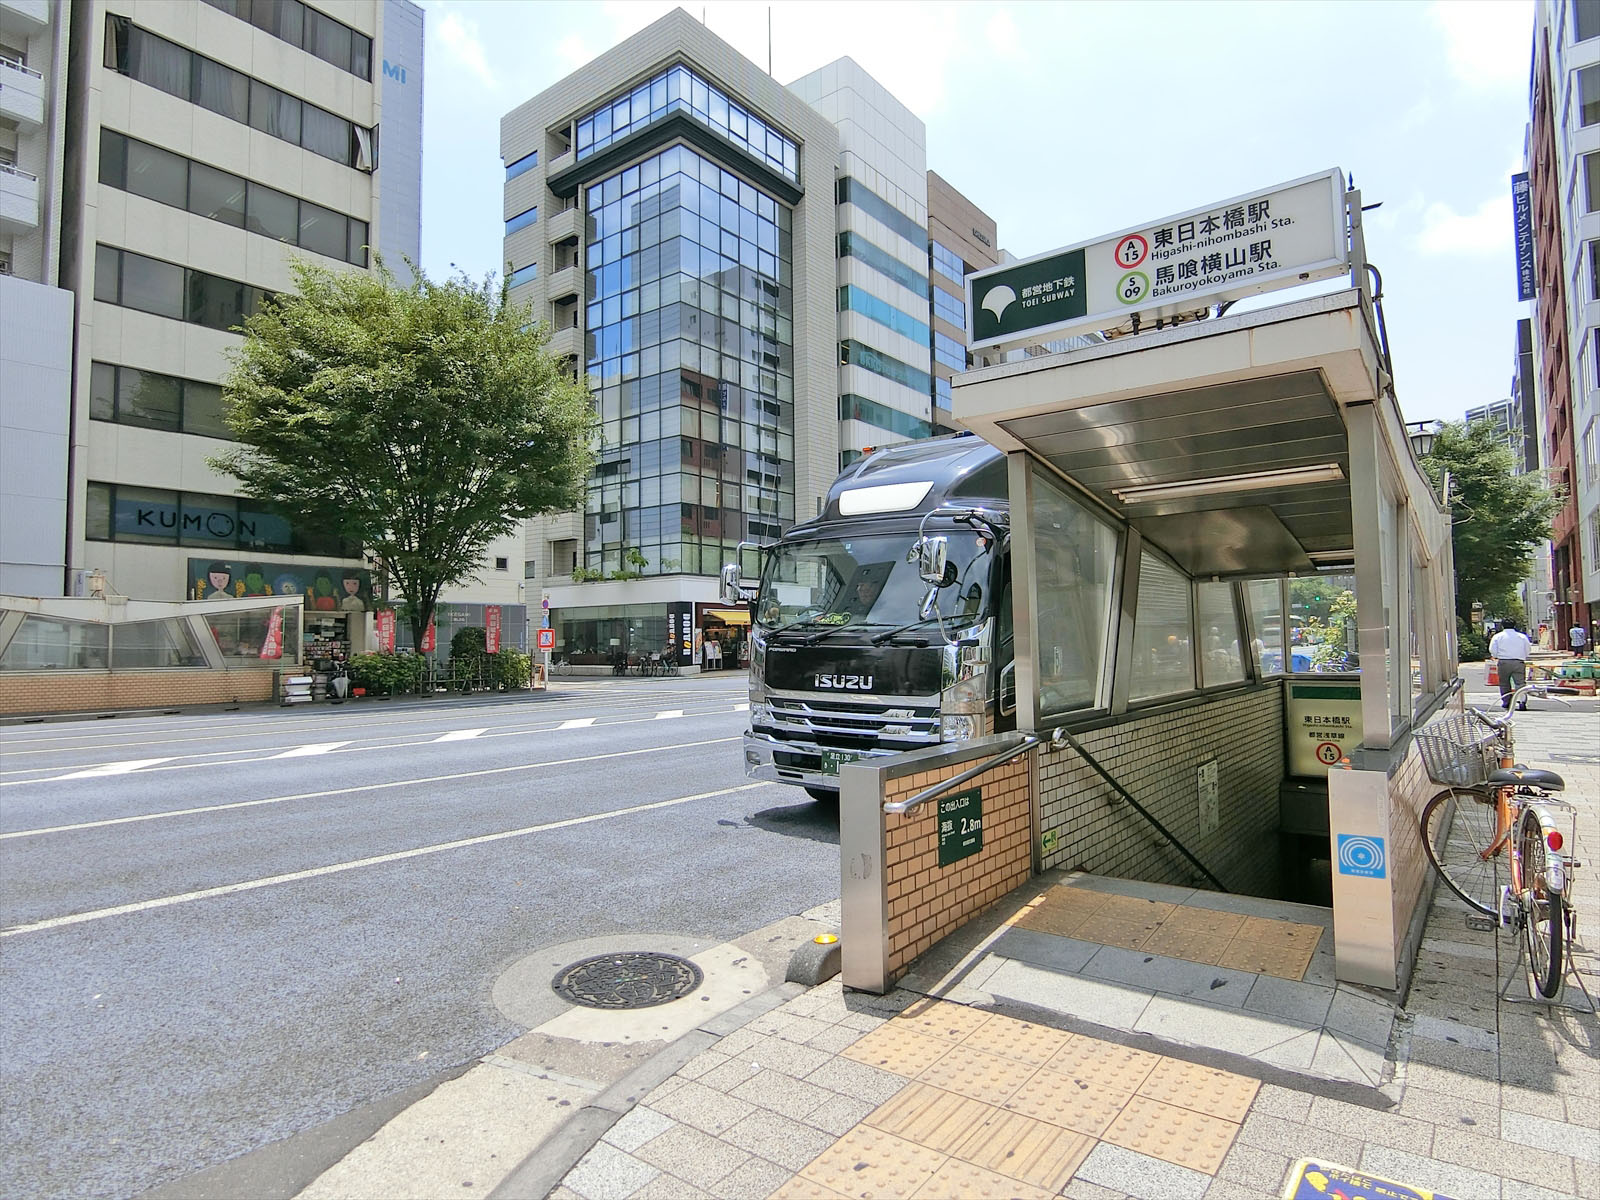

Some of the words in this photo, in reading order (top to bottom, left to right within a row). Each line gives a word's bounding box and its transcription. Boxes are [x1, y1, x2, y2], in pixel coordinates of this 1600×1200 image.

[1153, 200, 1270, 249] 東日本橋駅
[1127, 241, 1135, 251] A
[1151, 221, 1267, 261] Higashi-nihombashi
[1271, 217, 1295, 229] Sta.
[1125, 250, 1139, 262] 15
[1155, 240, 1272, 286] 馬喰横山駅
[1022, 276, 1075, 299] 都営地下鉄
[1129, 277, 1136, 287] S
[1152, 266, 1254, 297] Bakuroyokoyama
[1258, 261, 1282, 272] Sta.
[1022, 298, 1039, 309] TOEI
[1042, 289, 1075, 304] SUBWAY
[1125, 286, 1140, 298] 09
[138, 509, 255, 537] KUMON
[814, 673, 873, 690] ISUZU
[1304, 715, 1350, 725] 東日本橋駅
[1323, 753, 1335, 761] 15
[940, 796, 970, 814] この出入口は
[961, 817, 982, 835] 2.8m
